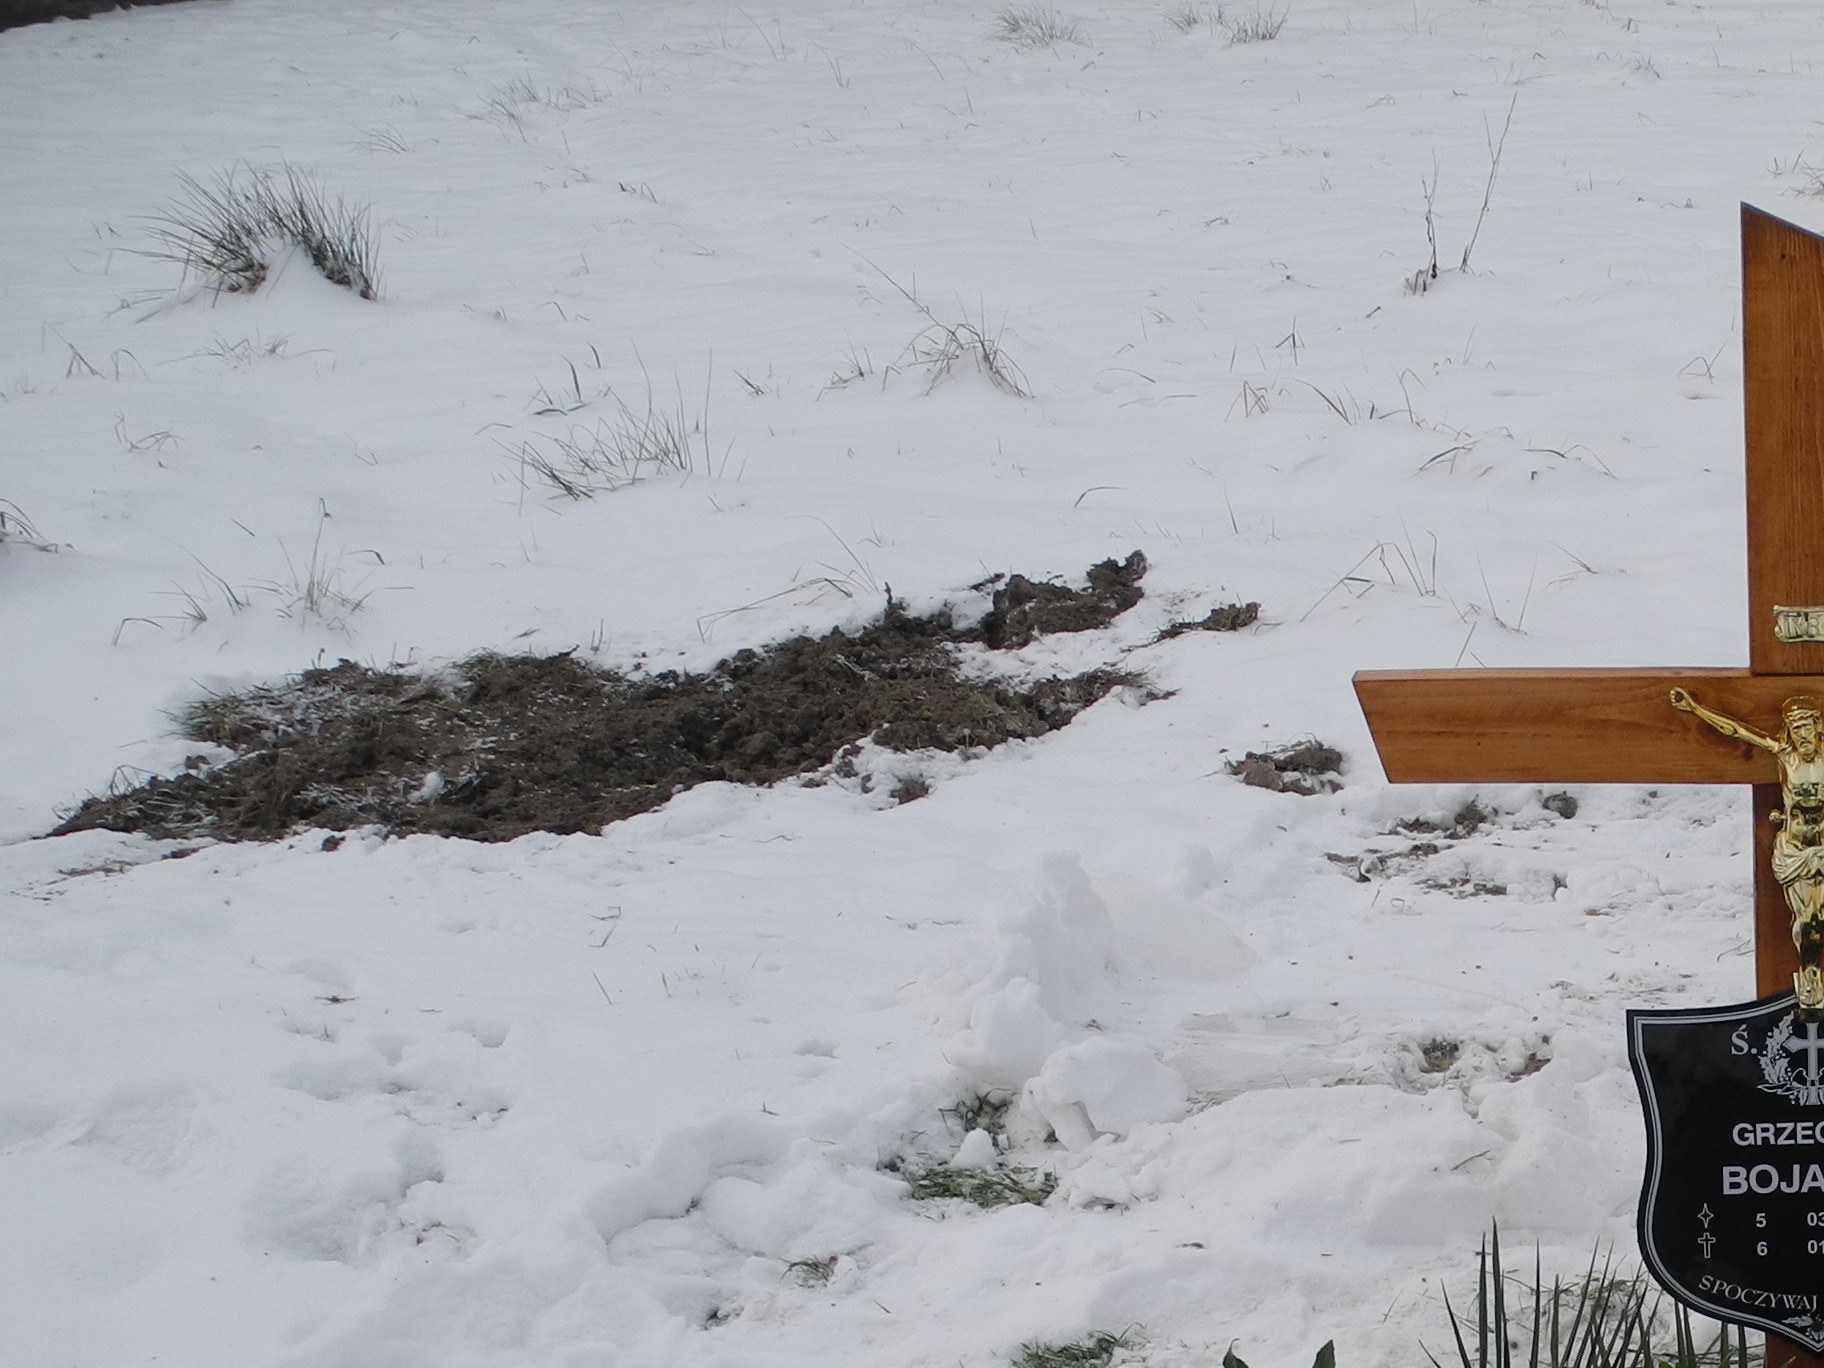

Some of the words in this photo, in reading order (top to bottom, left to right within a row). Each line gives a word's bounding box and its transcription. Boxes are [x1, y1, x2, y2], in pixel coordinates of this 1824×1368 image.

[1730, 1024, 1758, 1055] Ś.
[1755, 1212, 1767, 1228] 5
[1756, 1241, 1768, 1257] 6
[1698, 1274, 1819, 1313] SPOCZYWAJ
